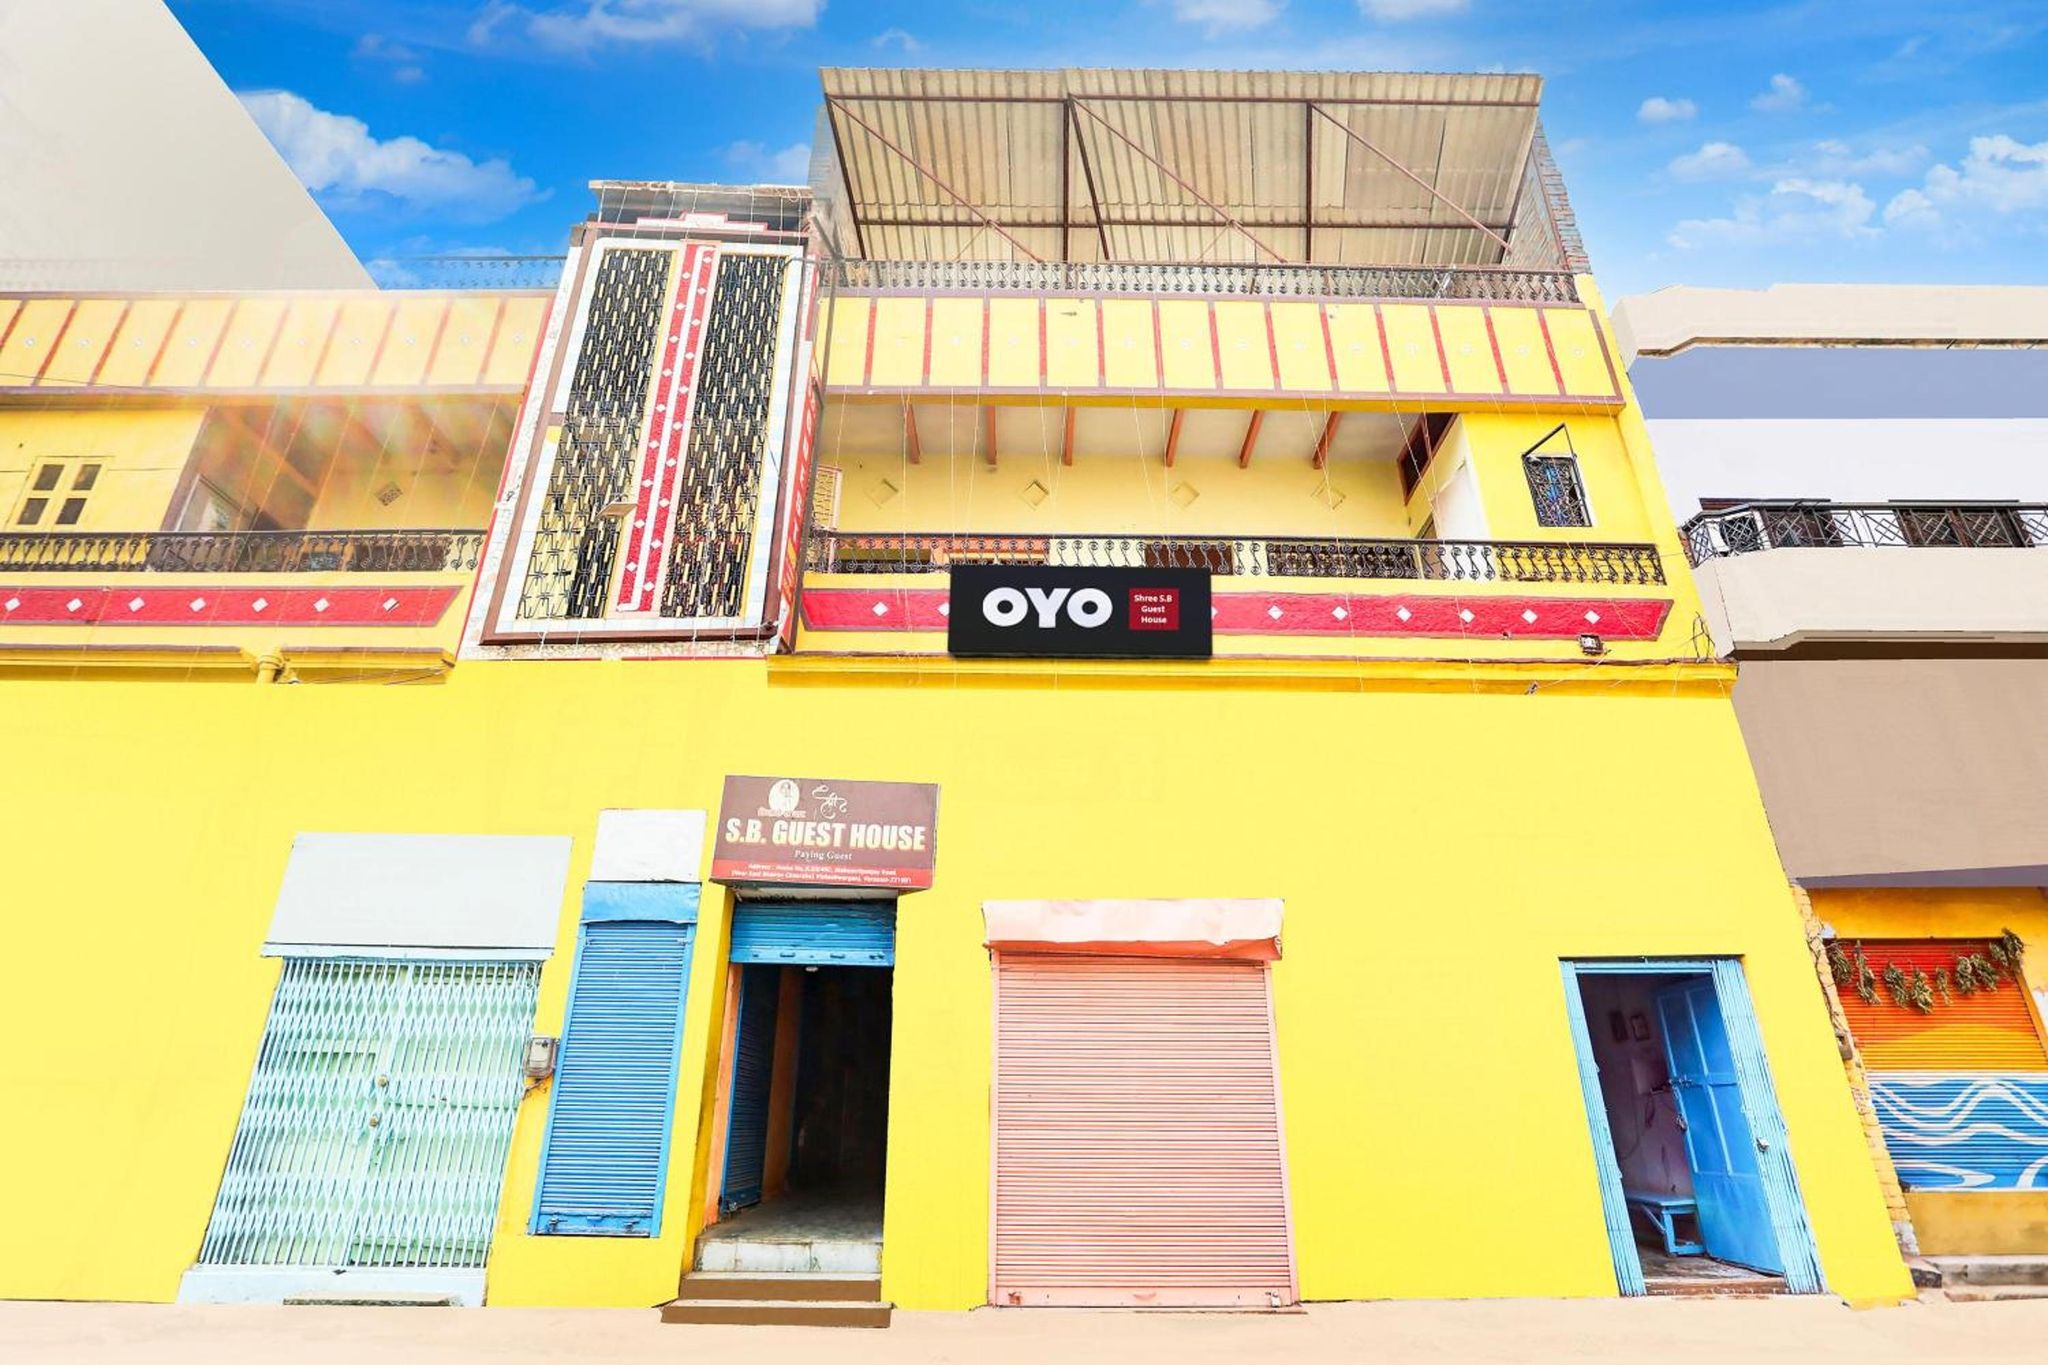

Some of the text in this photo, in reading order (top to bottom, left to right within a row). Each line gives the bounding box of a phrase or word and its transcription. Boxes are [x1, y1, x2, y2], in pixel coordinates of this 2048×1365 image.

[1134, 594, 1173, 603] Shree S.B
[982, 587, 1113, 628] OYO
[1141, 605, 1166, 613] Guest
[1141, 616, 1168, 624] House
[725, 818, 926, 851] S.B. GUEST HOUSE
[794, 849, 853, 862] Paying Guest
